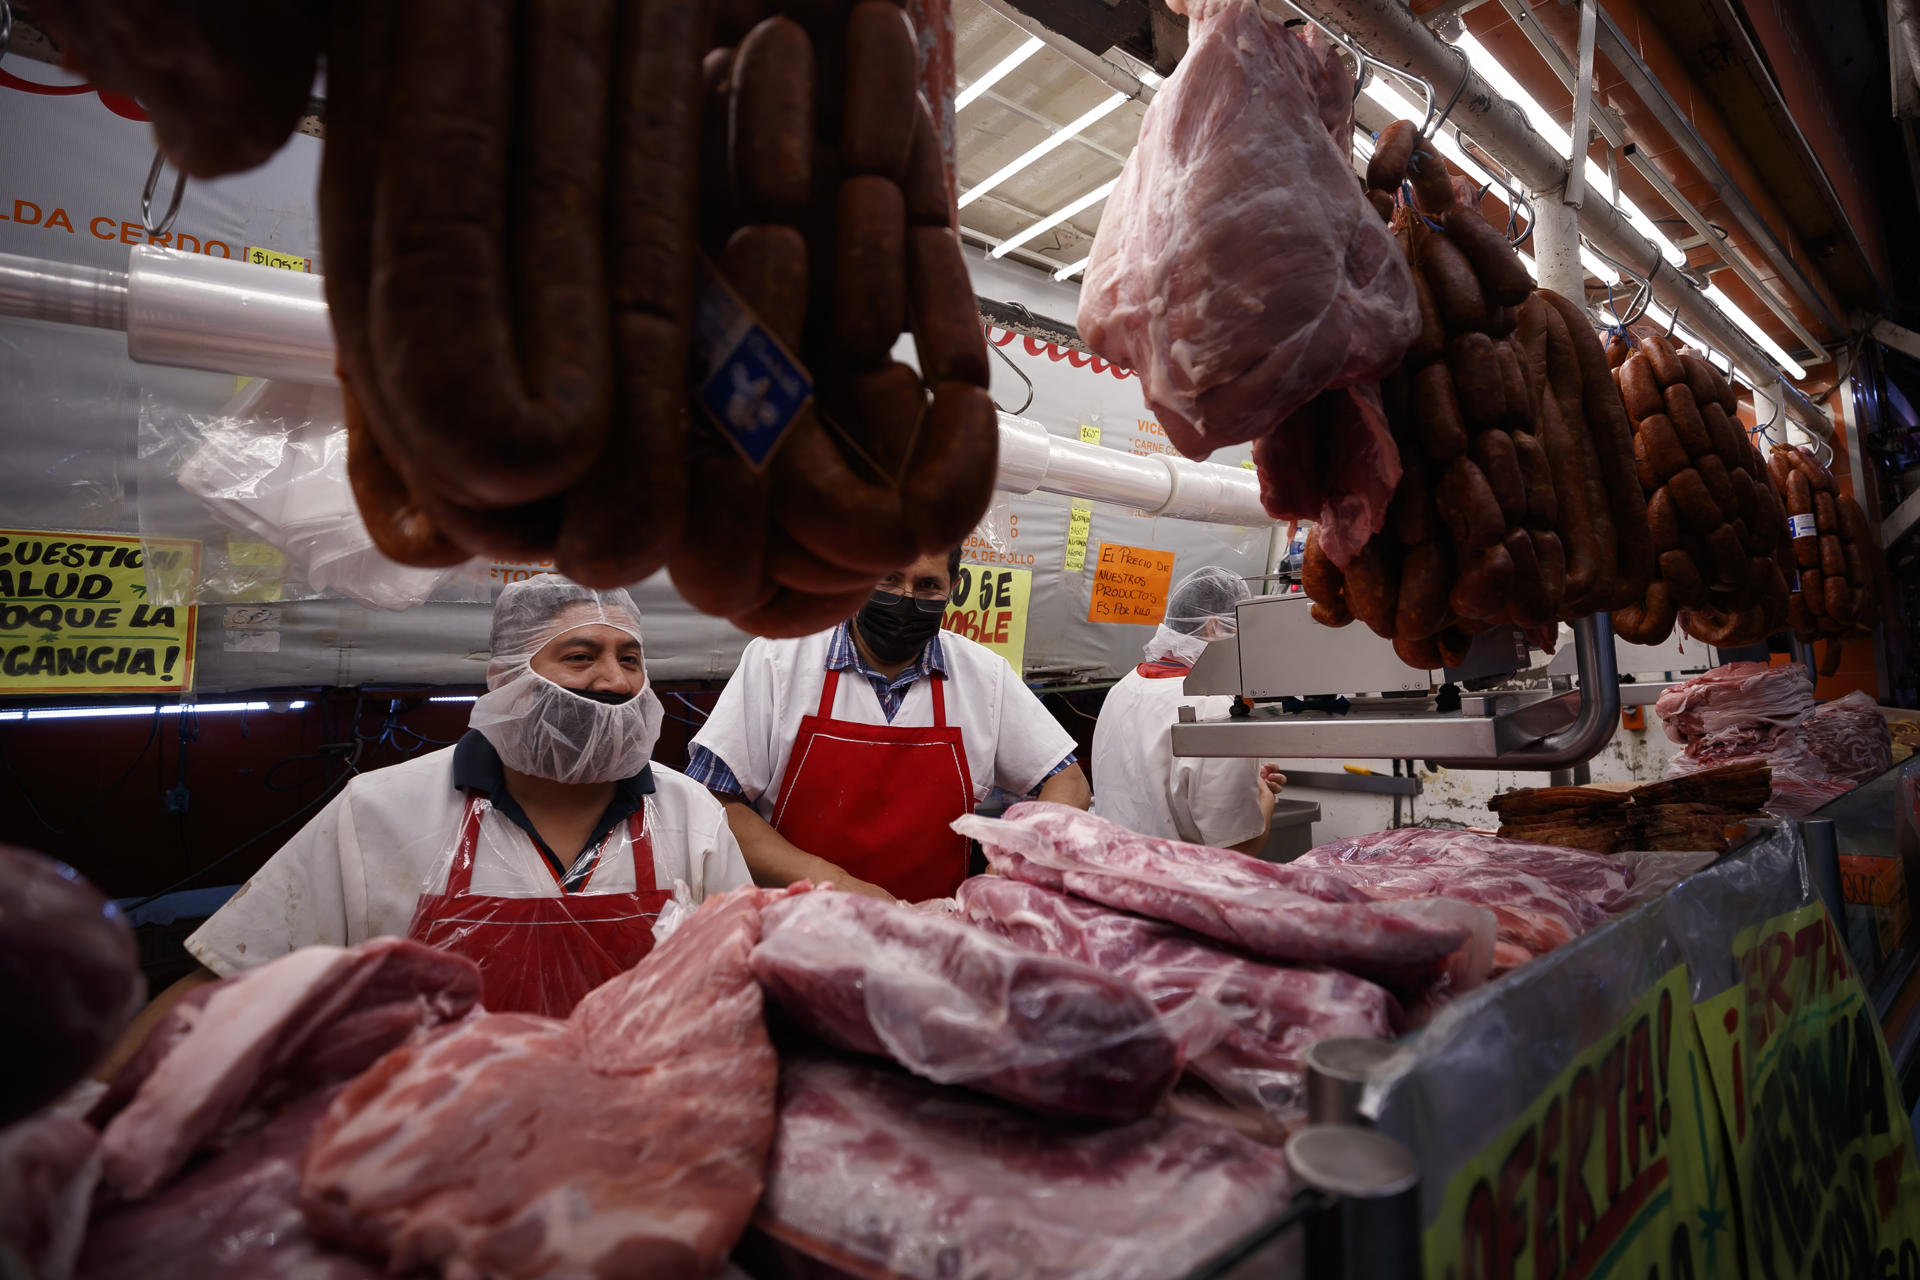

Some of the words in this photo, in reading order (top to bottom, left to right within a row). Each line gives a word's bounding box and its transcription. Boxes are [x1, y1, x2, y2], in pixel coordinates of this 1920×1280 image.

[1137, 418, 1168, 436] VICE
[1134, 439, 1163, 454] CARNE
[981, 551, 996, 562] DE
[999, 552, 1034, 565] POLLO
[1119, 547, 1152, 568] PRECIO
[1156, 562, 1170, 573] DE
[1099, 569, 1146, 587] NUESTROS
[979, 570, 1013, 611] SE
[1095, 582, 1157, 604] PRODUCTOS
[0, 602, 122, 632] OQUE
[128, 604, 175, 628] LA
[1096, 601, 1109, 615] ES
